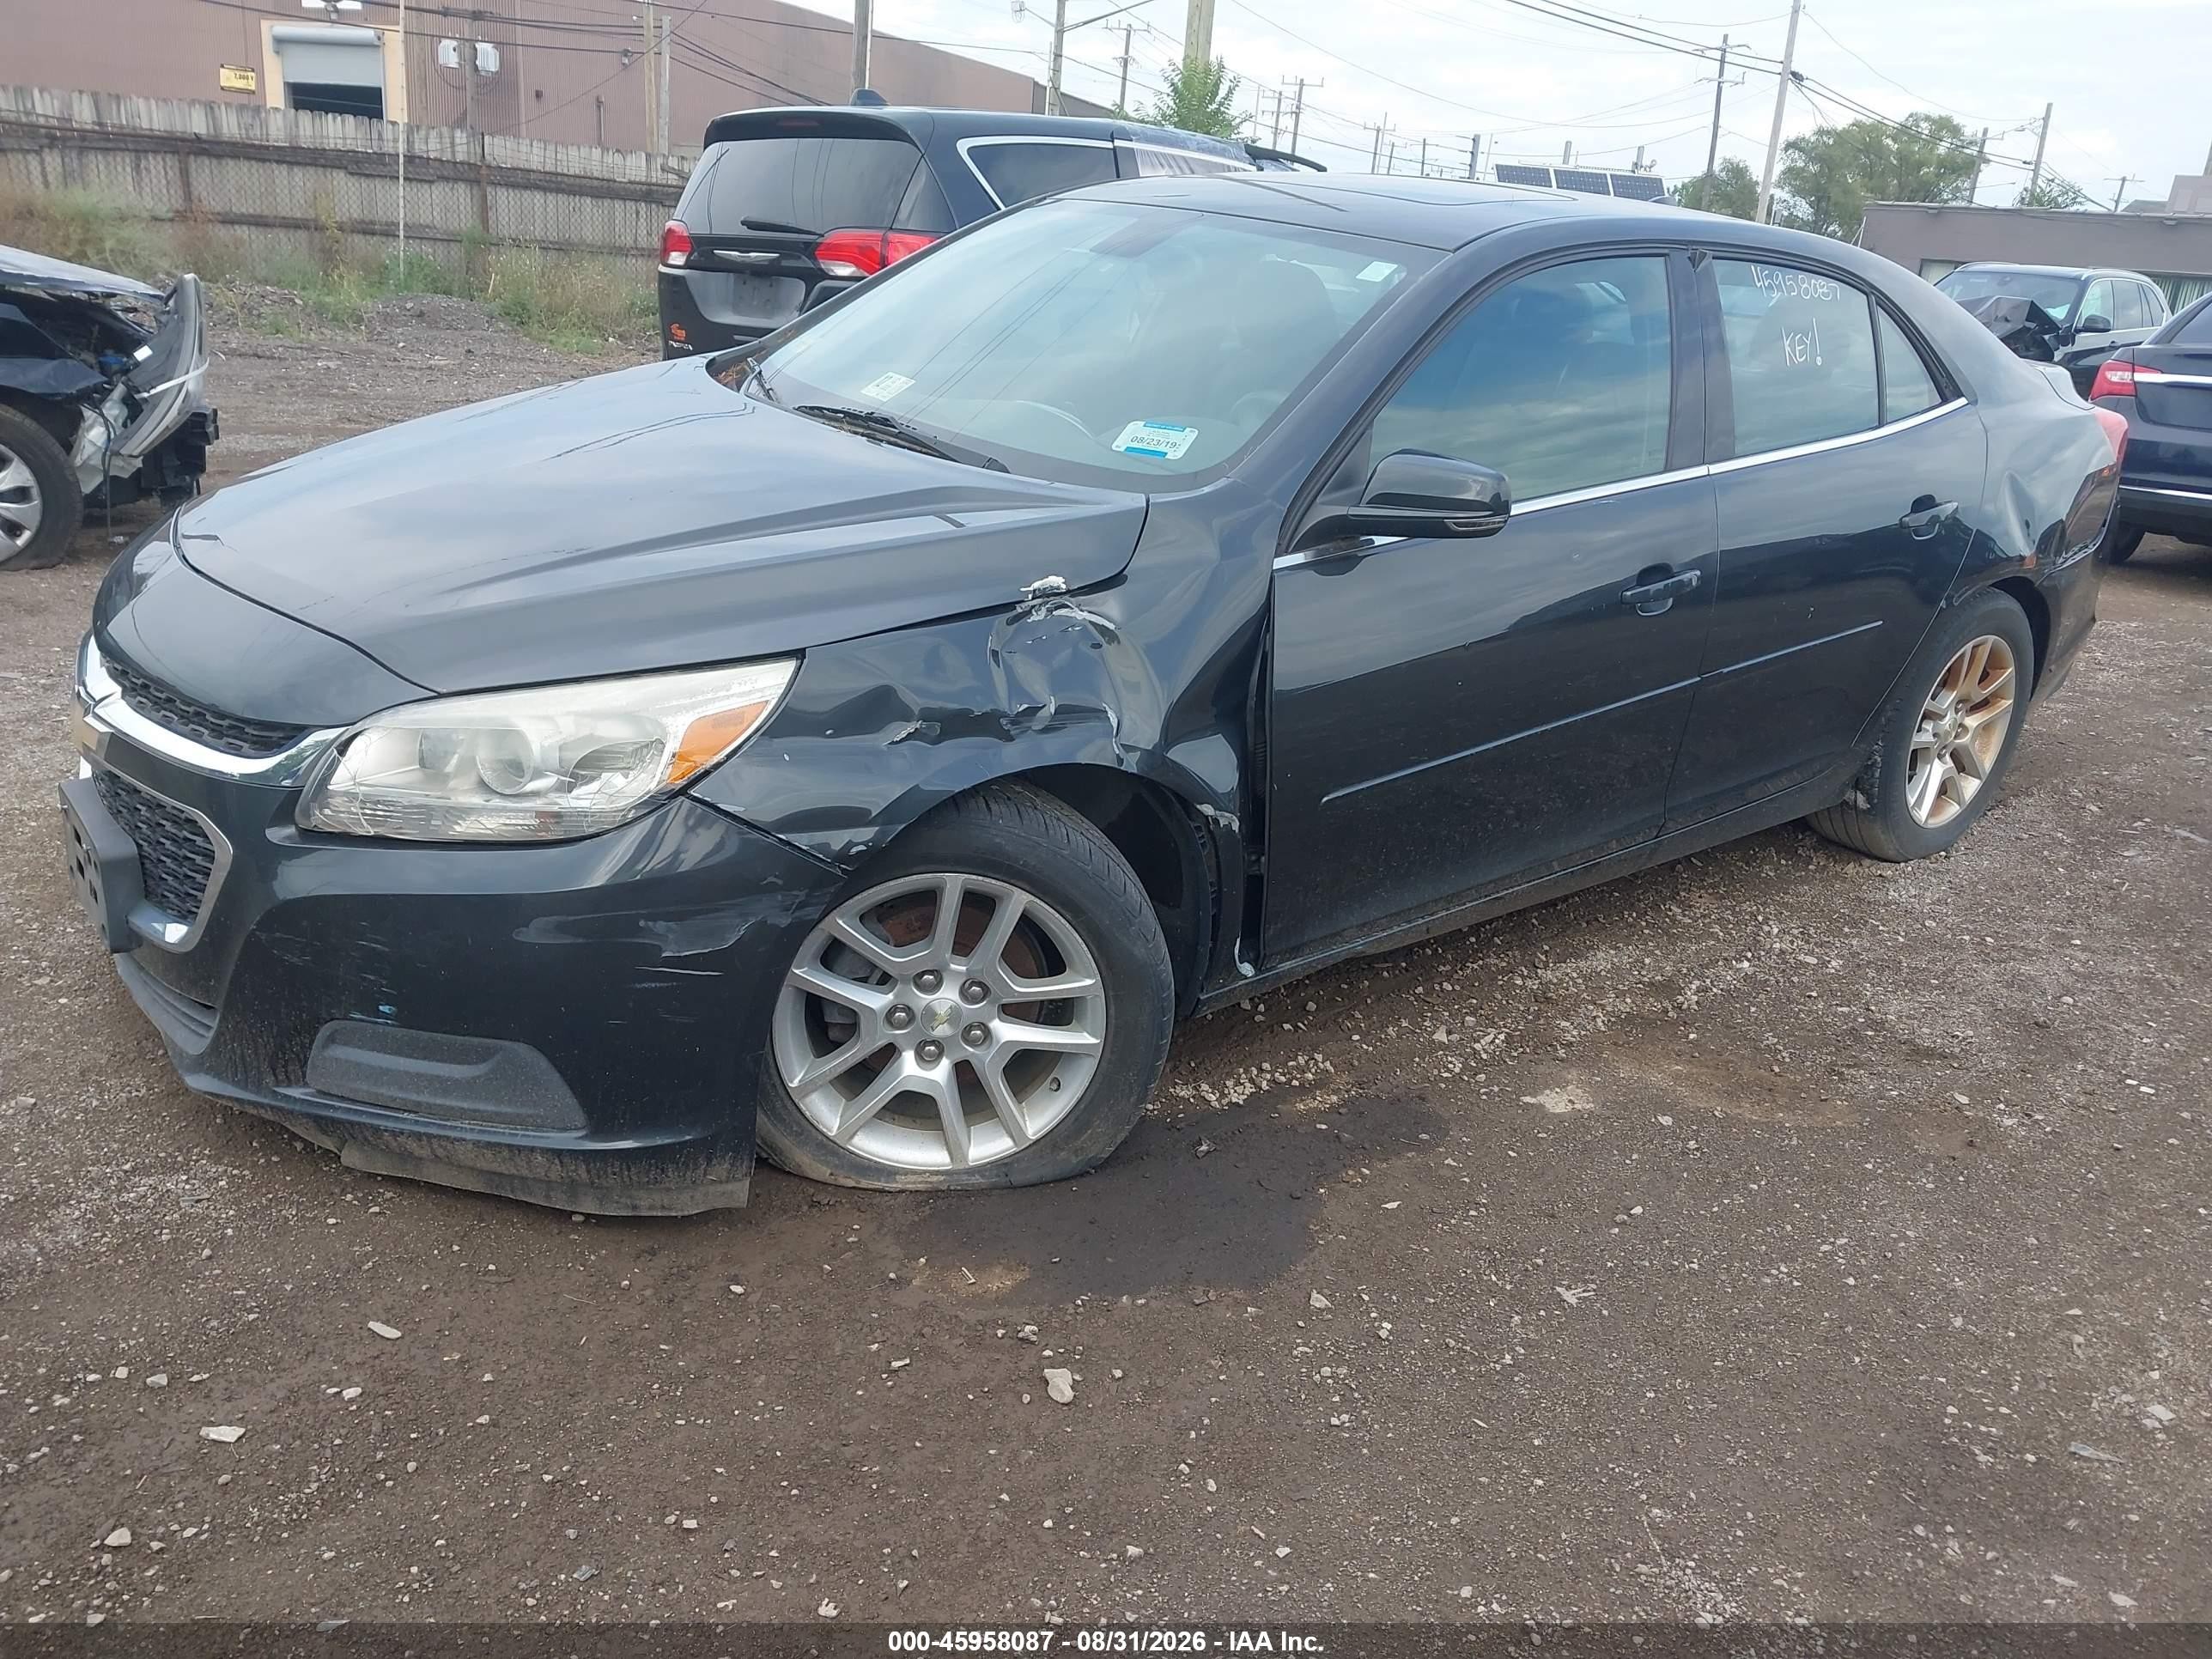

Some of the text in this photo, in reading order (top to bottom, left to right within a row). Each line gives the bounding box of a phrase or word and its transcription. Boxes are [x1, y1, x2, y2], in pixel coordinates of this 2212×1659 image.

[1751, 264, 1840, 301] 45958087
[1781, 317, 1822, 366] KEY!
[1130, 435, 1177, 449] 08/23/19
